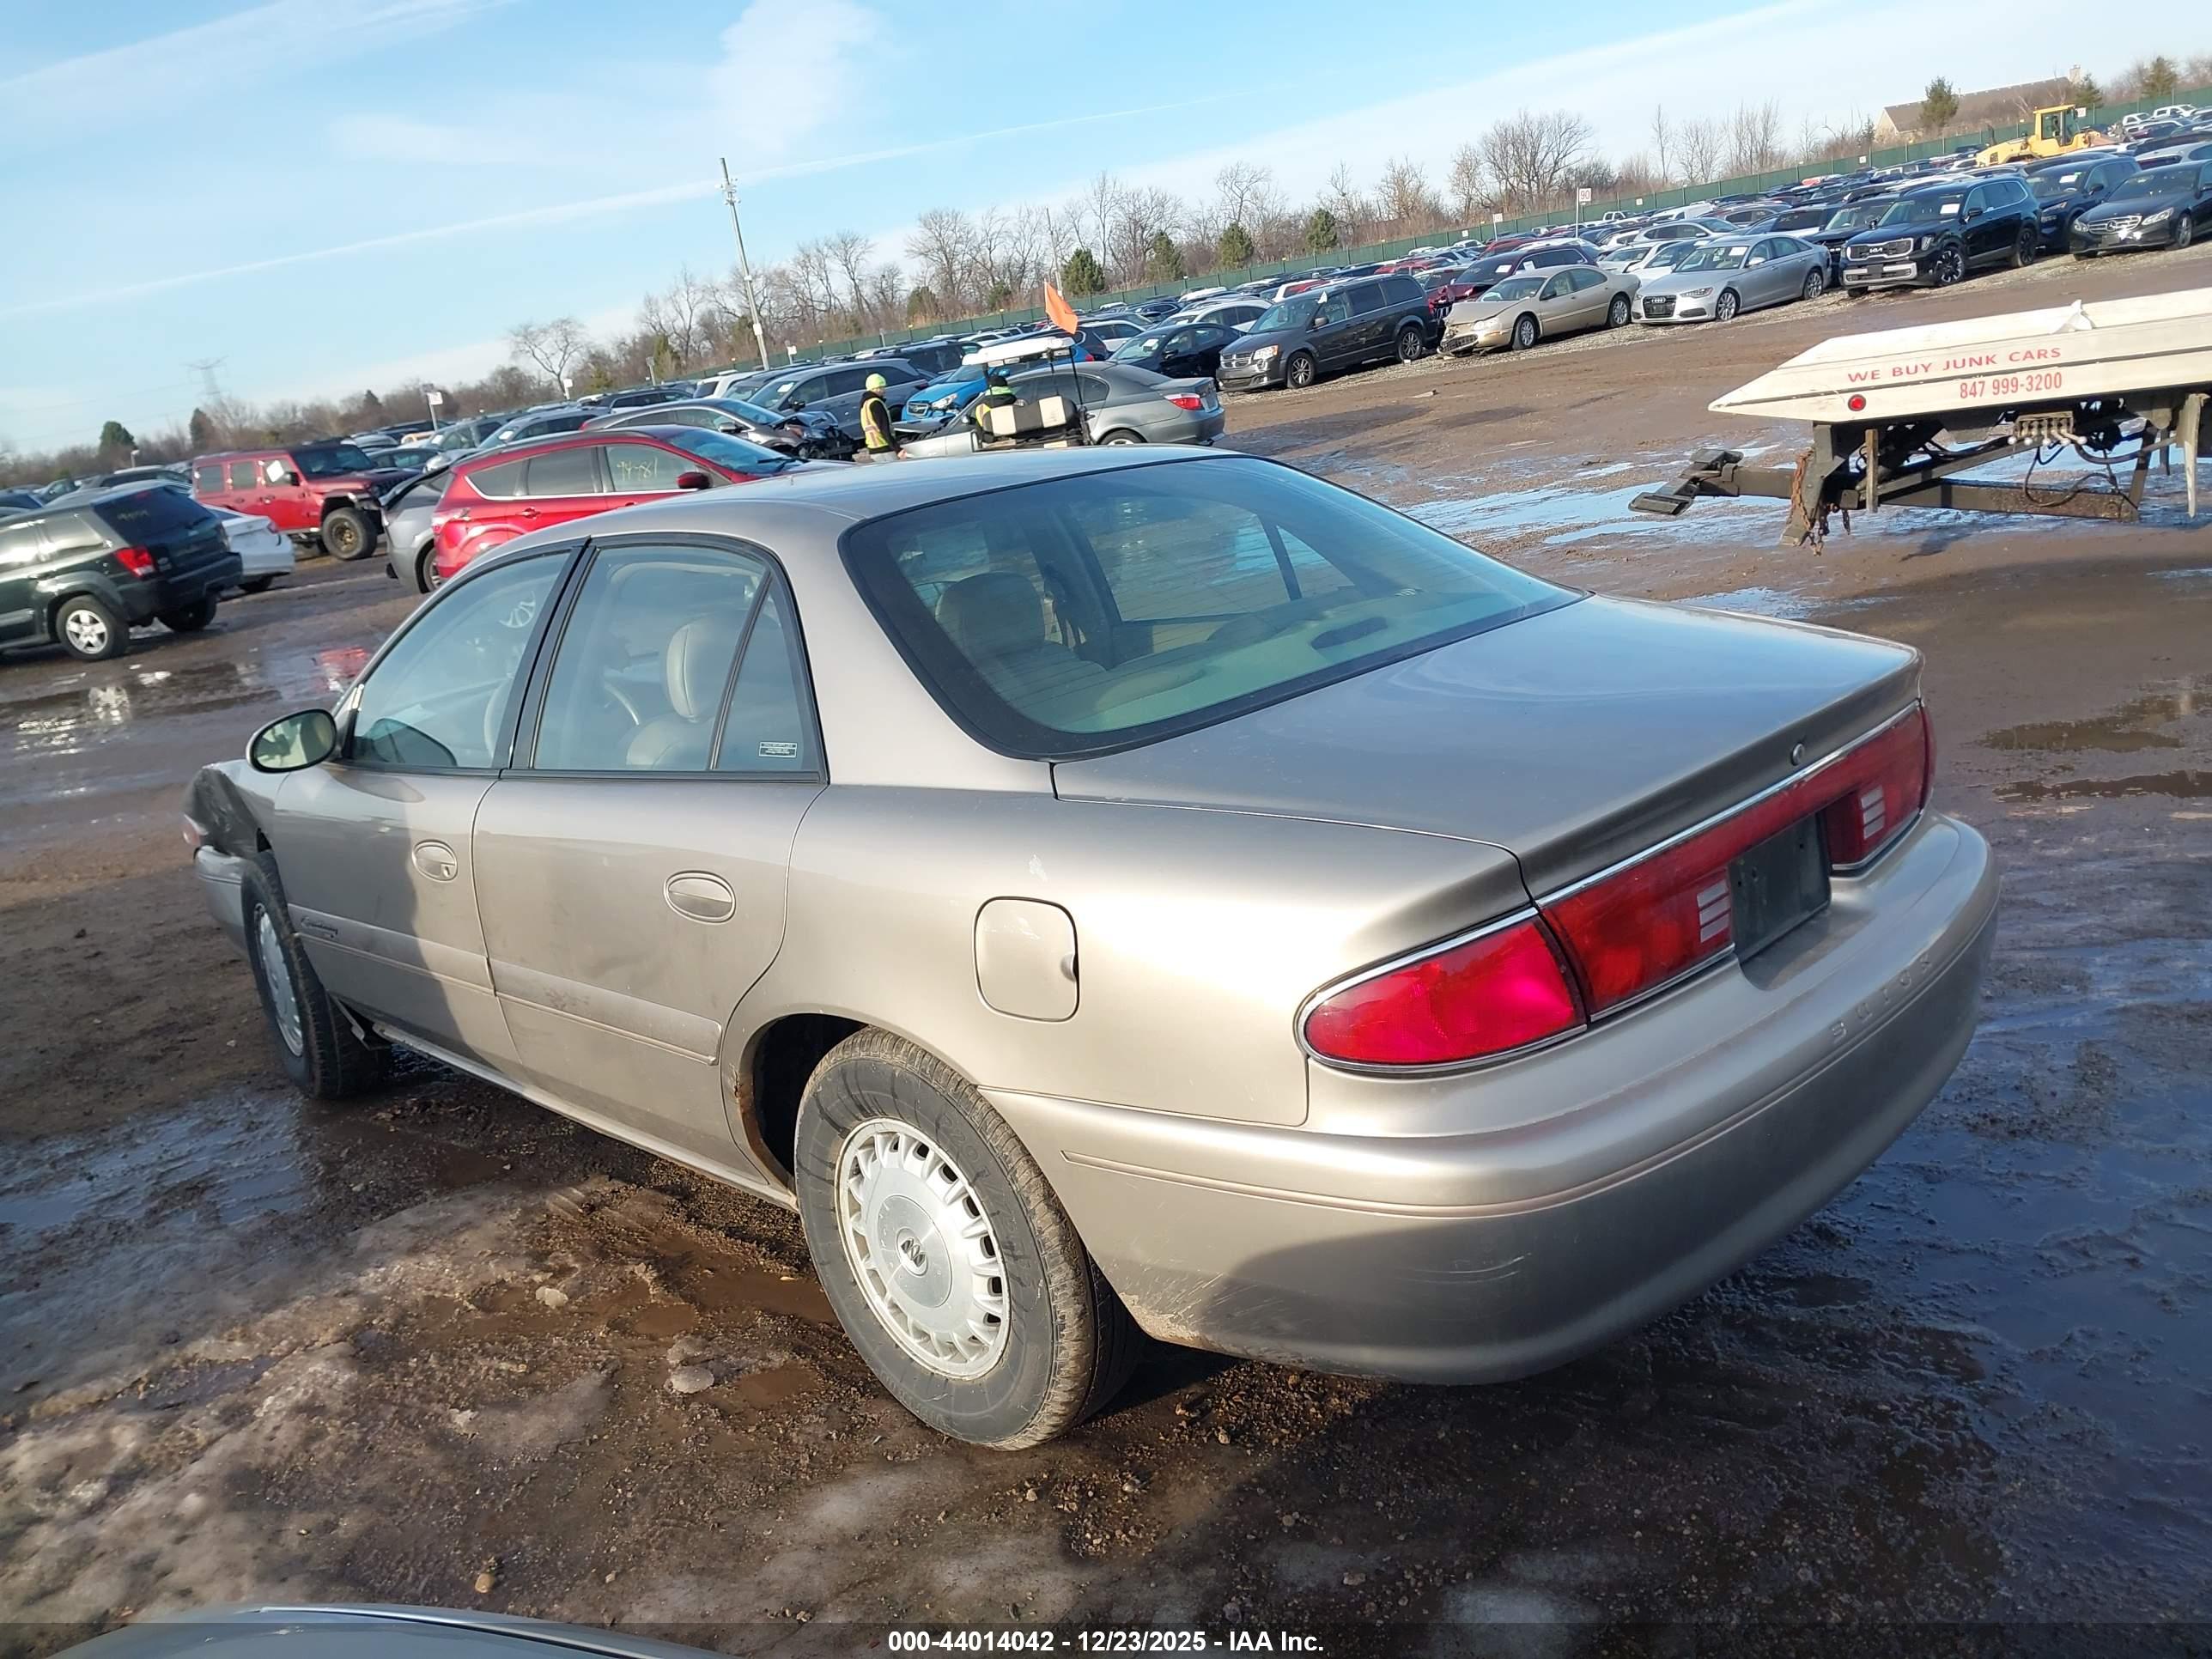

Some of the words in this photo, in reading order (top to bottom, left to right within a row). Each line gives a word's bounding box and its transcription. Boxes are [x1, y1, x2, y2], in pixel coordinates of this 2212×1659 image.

[1848, 369, 1881, 382] WE
[1892, 362, 1932, 377] BUY
[1942, 355, 1997, 370] JUNK
[2008, 348, 2061, 362] CARS
[1960, 380, 1986, 398] 847
[1993, 372, 2062, 395] 999-3200
